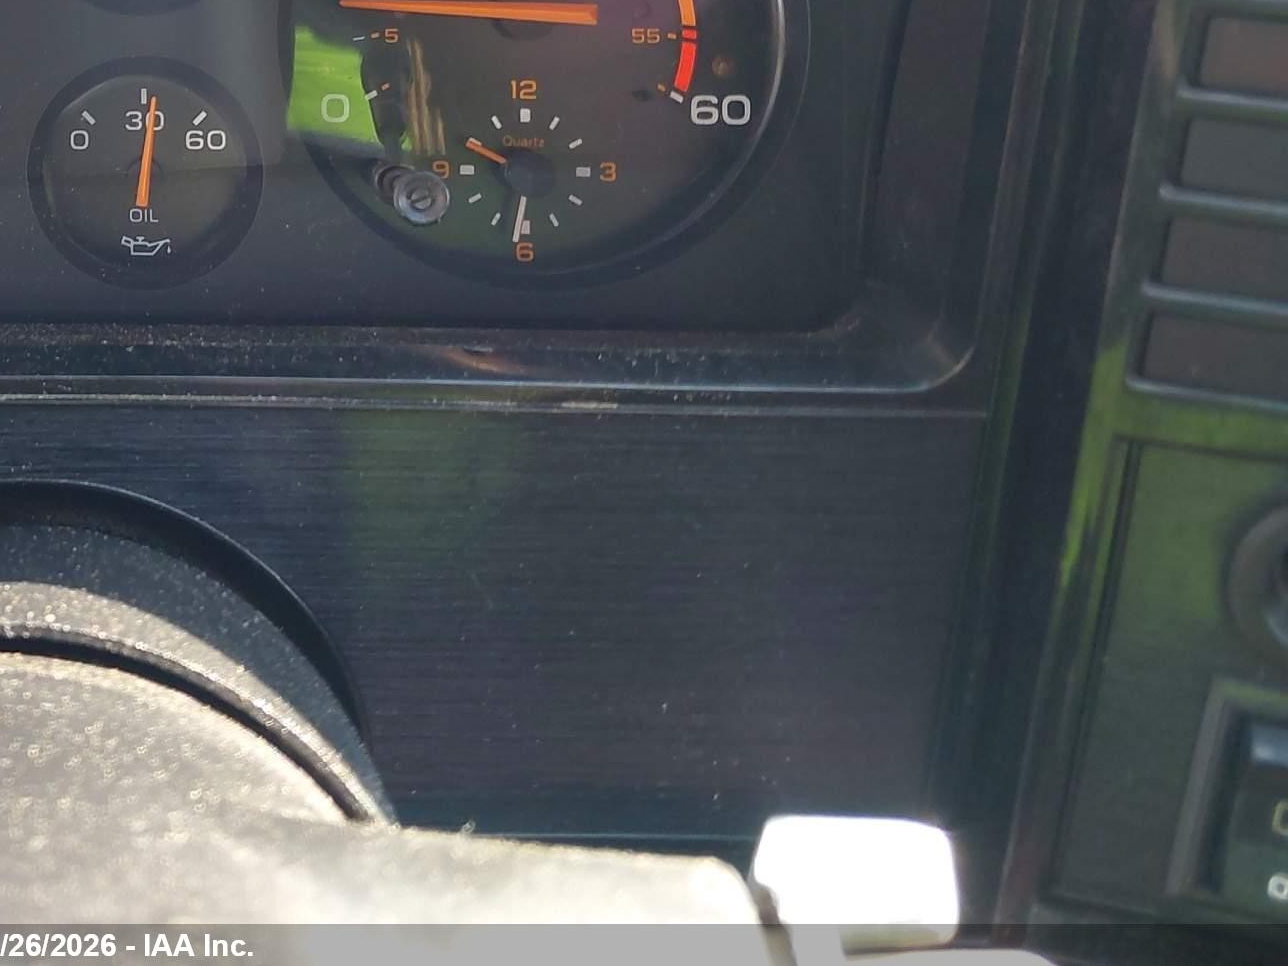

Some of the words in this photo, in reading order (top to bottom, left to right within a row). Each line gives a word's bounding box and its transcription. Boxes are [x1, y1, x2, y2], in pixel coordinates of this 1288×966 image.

[385, 29, 399, 44] 5
[631, 29, 661, 44] 55
[510, 80, 537, 99] 12
[321, 94, 350, 123] 0
[690, 95, 751, 125] 60
[125, 111, 165, 131] 30
[70, 131, 89, 151] 0
[185, 130, 226, 151] 60
[502, 135, 545, 148] Quartz
[432, 161, 450, 179] 9
[600, 162, 617, 181] 3
[129, 207, 159, 223] OIL
[516, 243, 534, 262] 6
